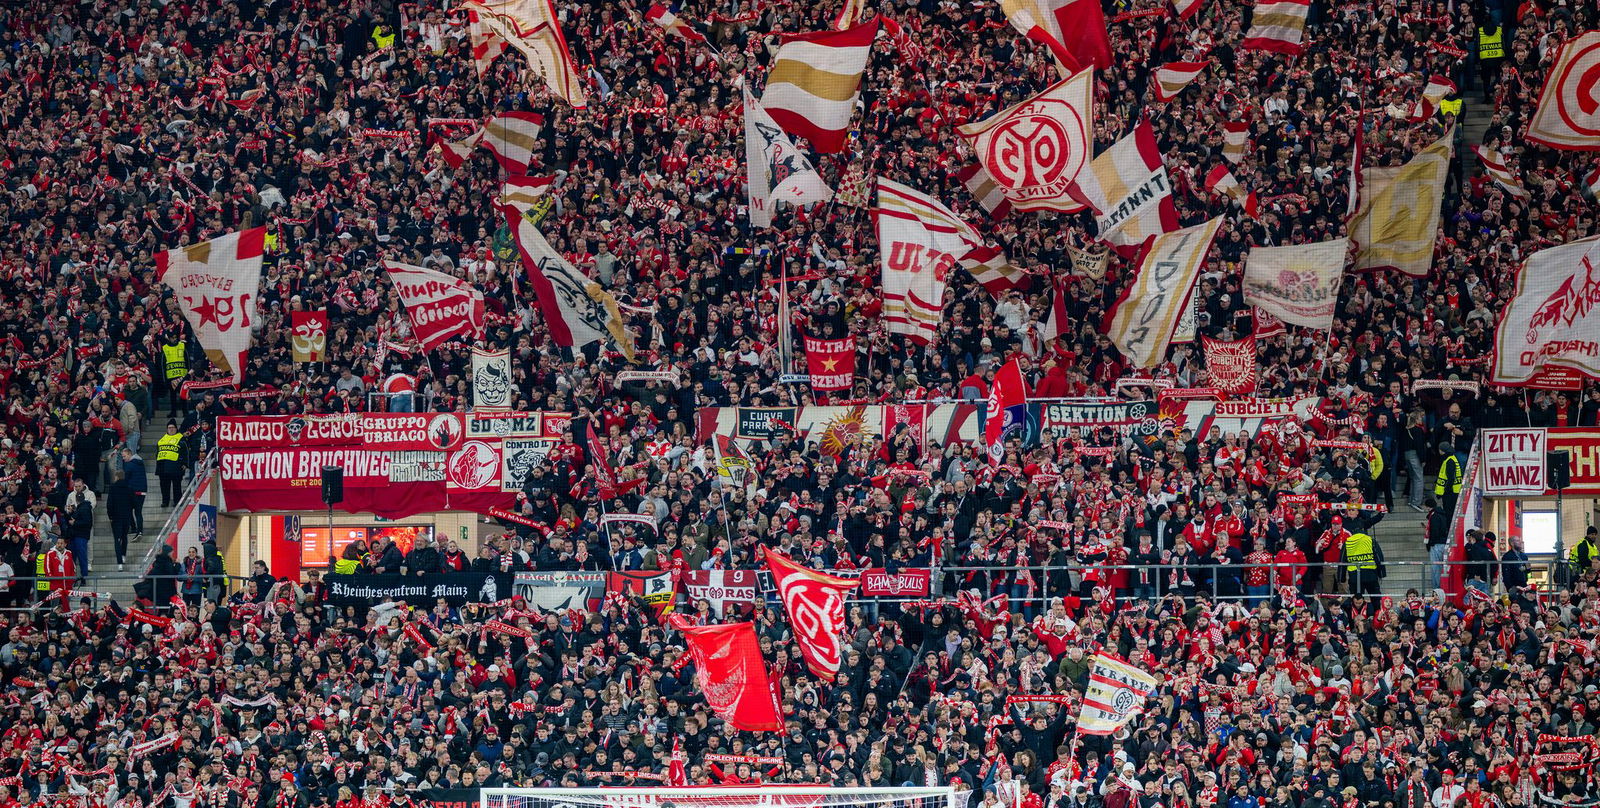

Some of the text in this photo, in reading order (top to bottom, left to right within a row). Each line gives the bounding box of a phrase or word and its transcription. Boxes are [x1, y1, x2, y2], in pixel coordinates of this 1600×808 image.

[806, 339, 855, 353] ULTRA
[811, 373, 853, 388] SZENE
[1050, 406, 1128, 423] SEKTION
[1215, 401, 1296, 415] SUBCIETY
[363, 417, 427, 430] GRUPPO
[471, 417, 536, 433] SD MZ
[364, 430, 427, 444] UBRIACO
[1488, 433, 1541, 453] ZITTY
[505, 440, 540, 449] CONTRO
[222, 450, 390, 480] SEKTION BRUCHWEG
[1490, 465, 1540, 486] MAINZ
[290, 479, 323, 487] SEIT 200
[733, 571, 744, 583] 9
[867, 576, 890, 588] BAM
[899, 577, 924, 589] BULIS
[332, 583, 468, 598] Rheinhessenfront Mainz
[725, 587, 754, 599] RAS
